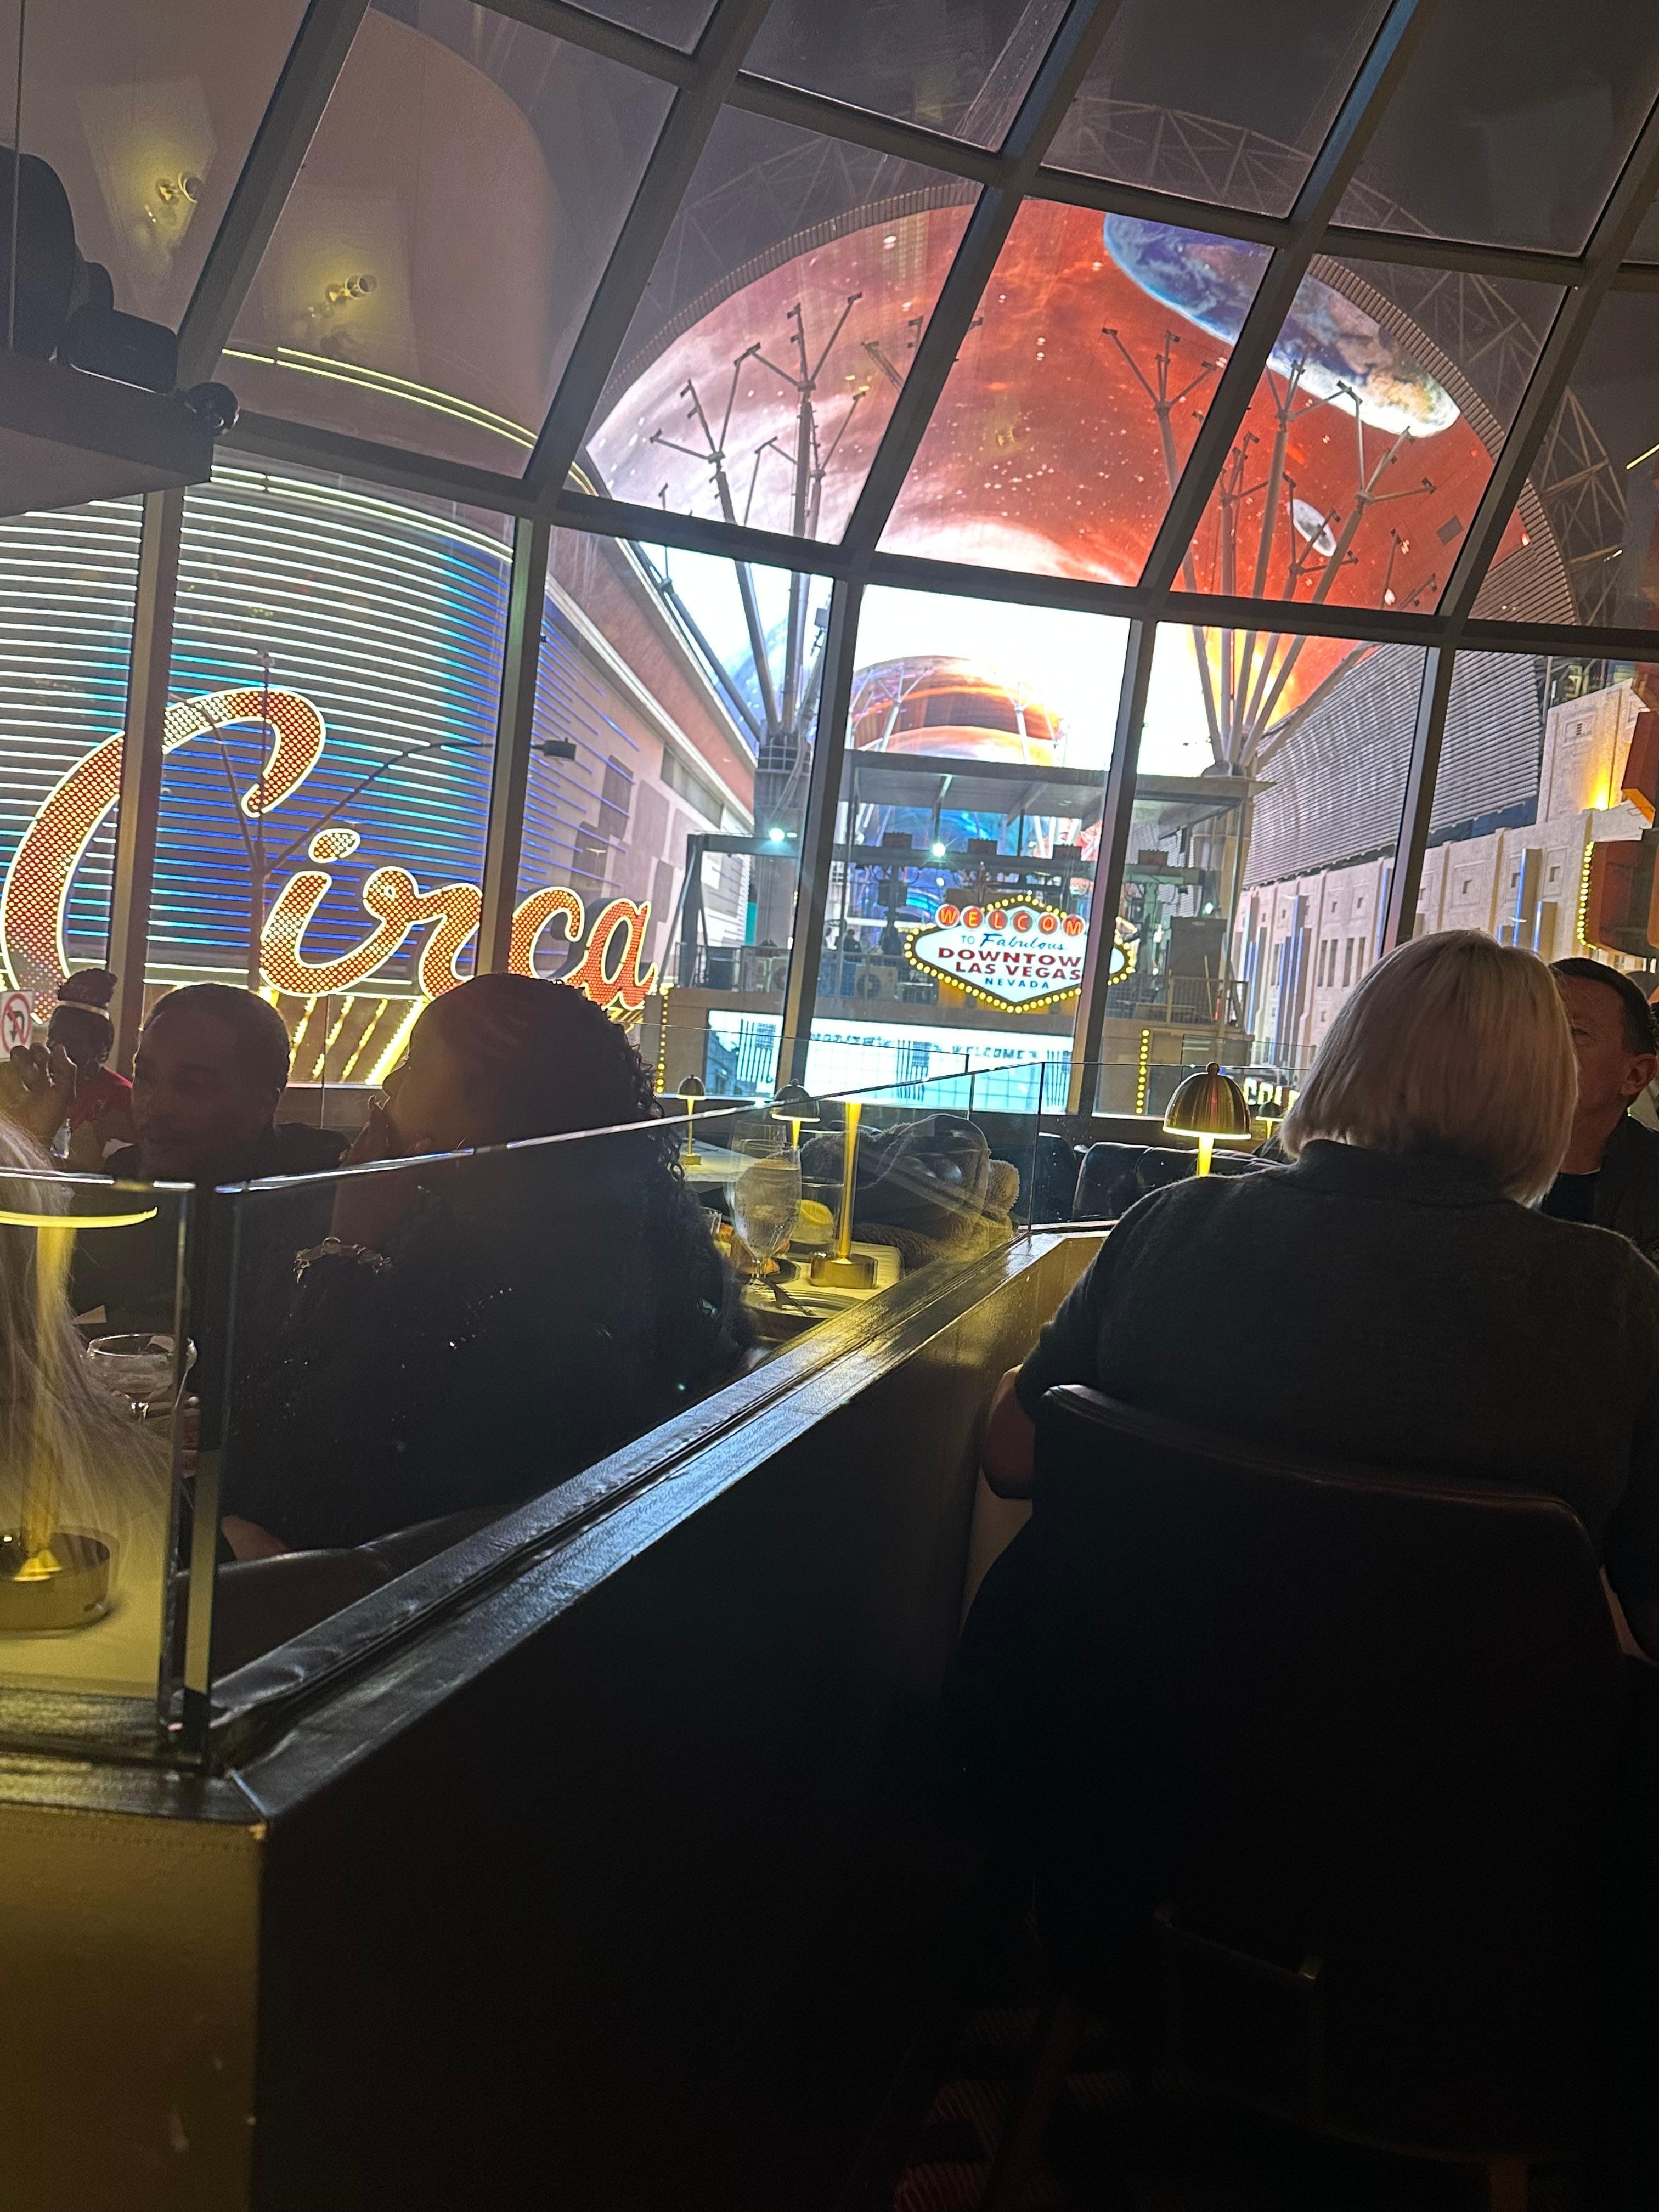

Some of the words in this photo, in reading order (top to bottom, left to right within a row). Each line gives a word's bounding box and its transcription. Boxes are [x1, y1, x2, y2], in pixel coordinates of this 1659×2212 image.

[2, 687, 657, 1024] Circa
[940, 909, 1081, 936] WELCOM
[961, 935, 975, 944] TO
[979, 933, 1067, 950] Fabulous
[938, 947, 1082, 967] DOWNTOW
[956, 962, 996, 975] LAS
[1005, 965, 1081, 980] VEGAS
[985, 978, 1049, 989] NEVADA
